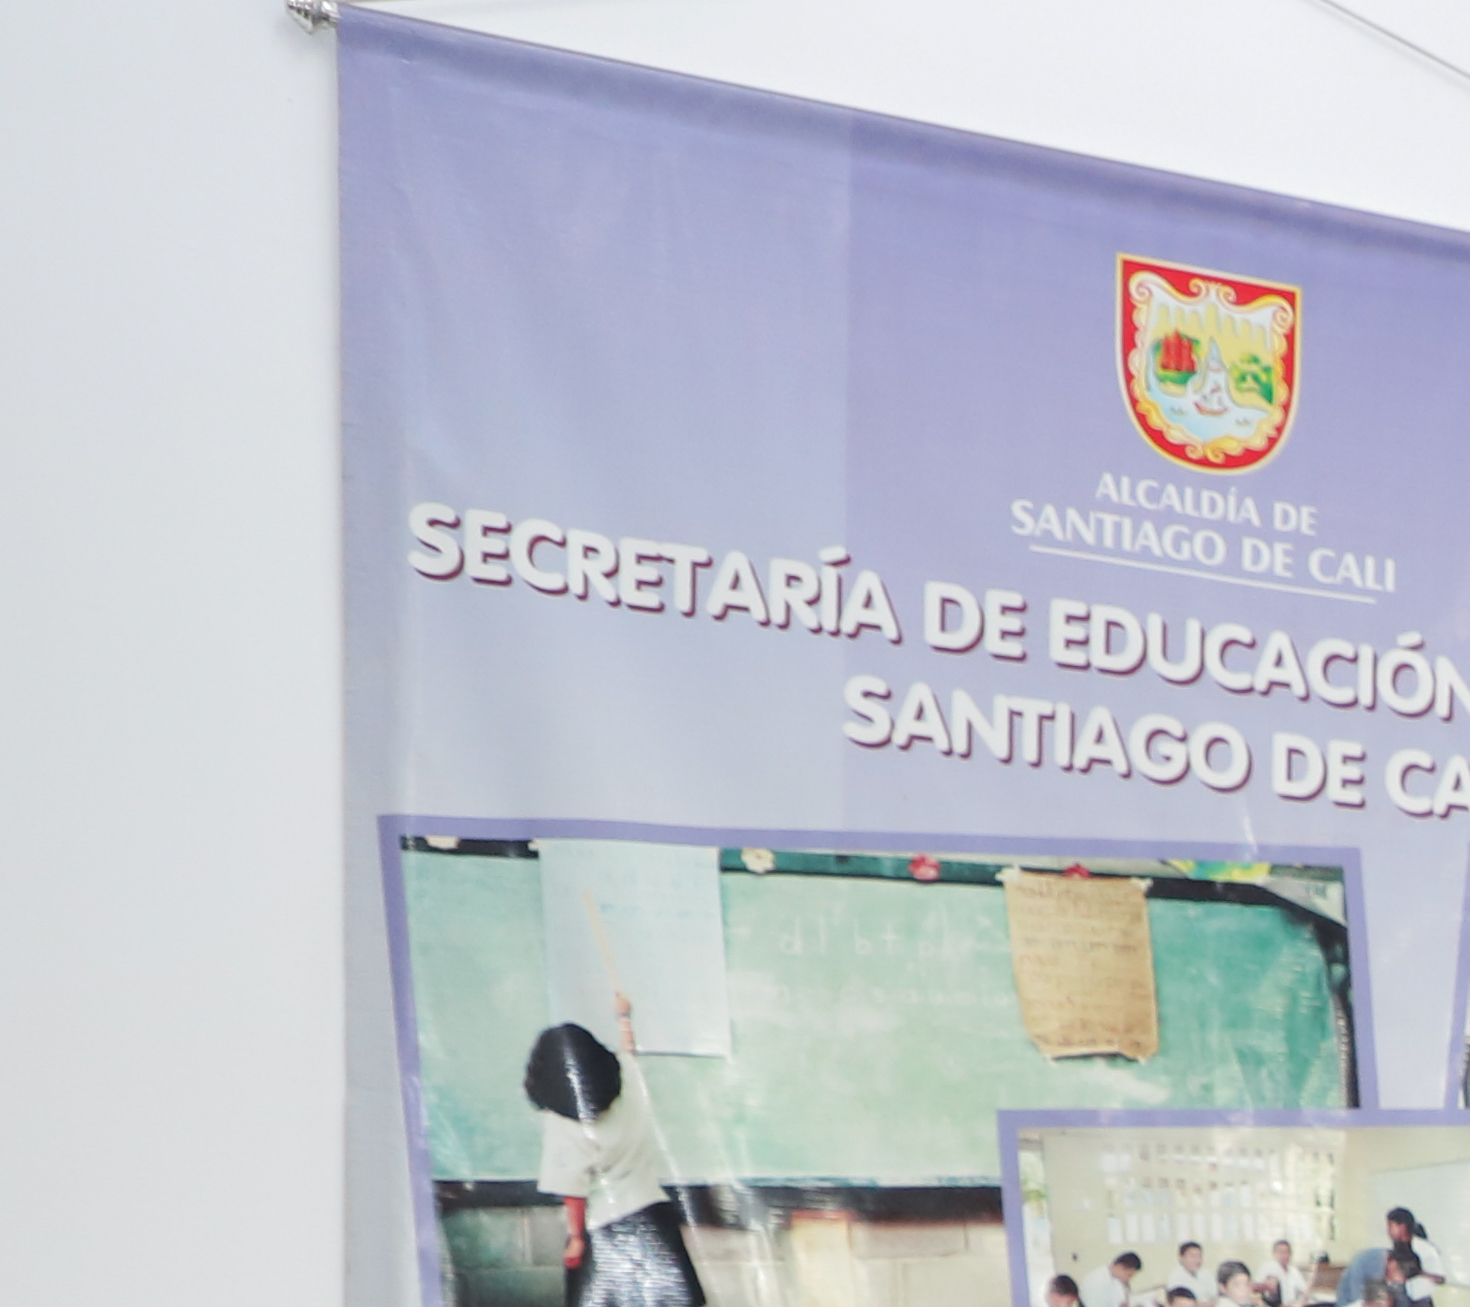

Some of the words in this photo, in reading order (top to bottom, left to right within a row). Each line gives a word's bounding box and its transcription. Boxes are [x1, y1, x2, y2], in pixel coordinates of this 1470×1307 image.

[1010, 498, 1227, 569] SANTIAGO
[1240, 538, 1295, 582] DE
[1307, 548, 1397, 593] CALI
[1095, 471, 1263, 529] ALCALDÍA
[1273, 501, 1318, 537] DE
[406, 501, 903, 645] SECRETARÍA
[923, 579, 1027, 662] DE
[842, 674, 1253, 792] SANTIAGO
[1271, 732, 1367, 808] DE
